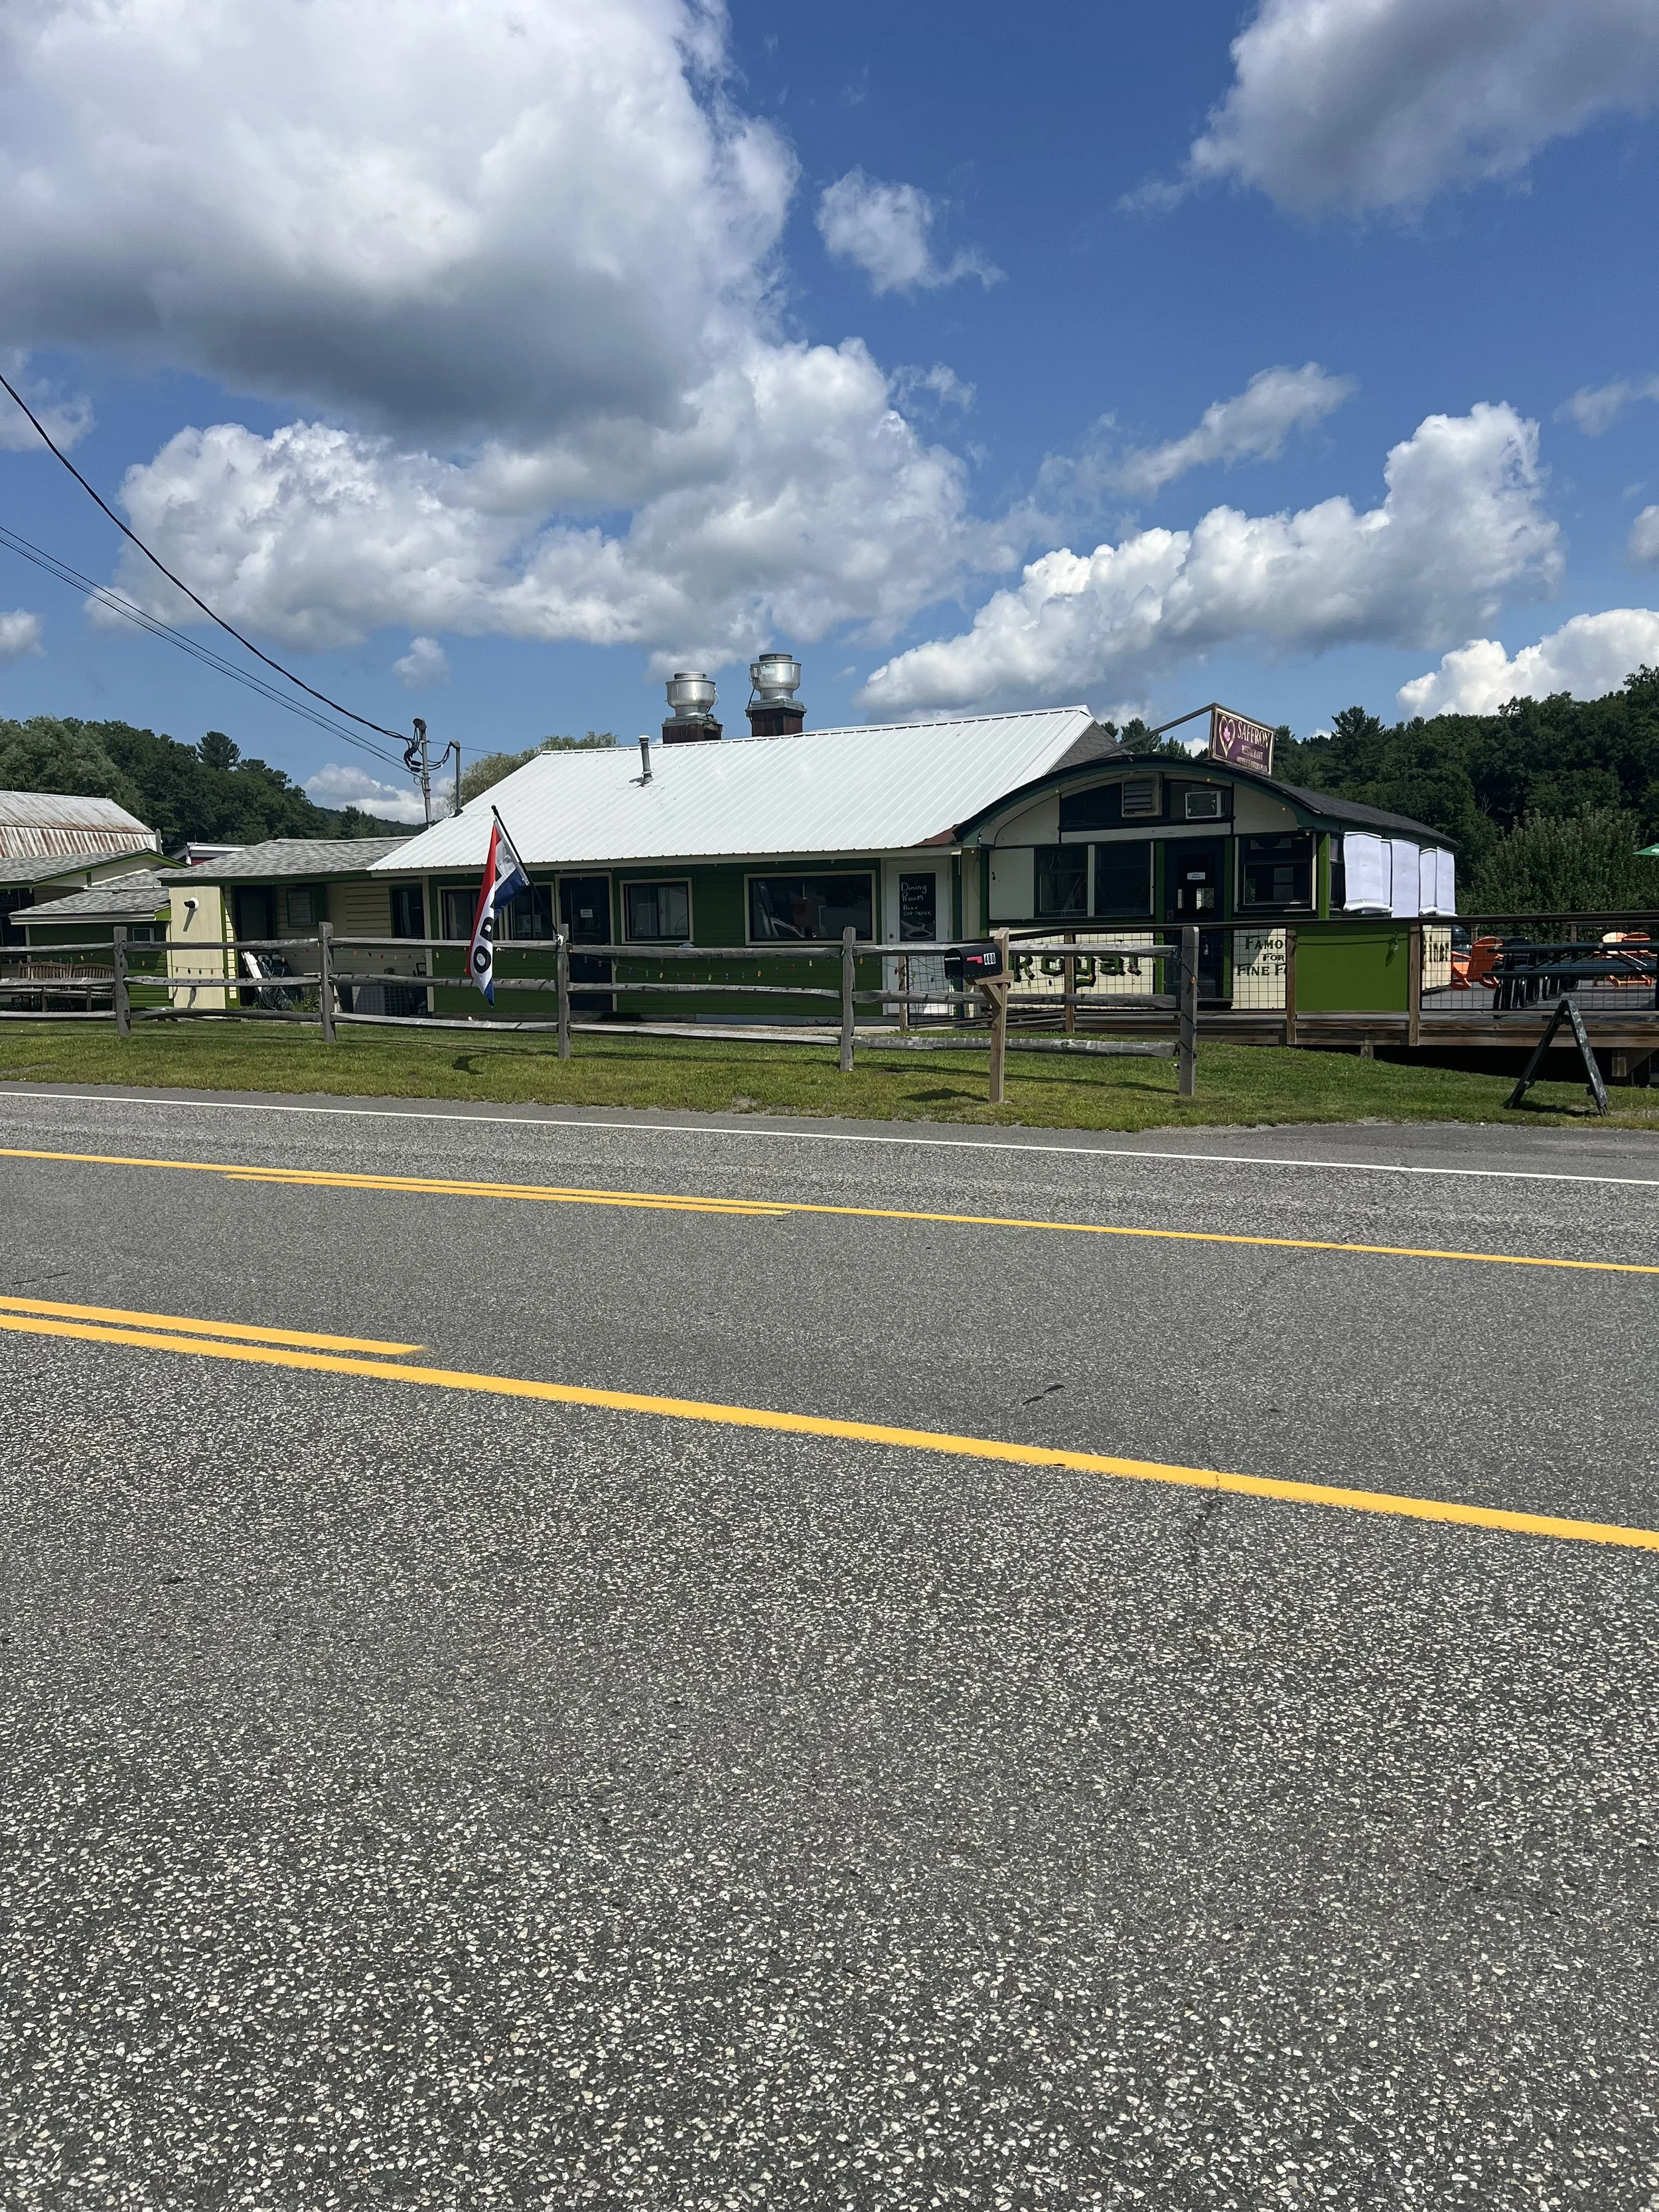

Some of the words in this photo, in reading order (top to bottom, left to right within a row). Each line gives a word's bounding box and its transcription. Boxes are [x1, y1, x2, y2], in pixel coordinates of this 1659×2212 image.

[1237, 721, 1269, 749] SAFFRON
[1241, 744, 1263, 761] RESTAURANT
[901, 881, 927, 895] Dining
[902, 891, 924, 903] Room
[1244, 936, 1285, 950] FAMO
[984, 953, 995, 964] 480
[1236, 963, 1270, 976] FINE
